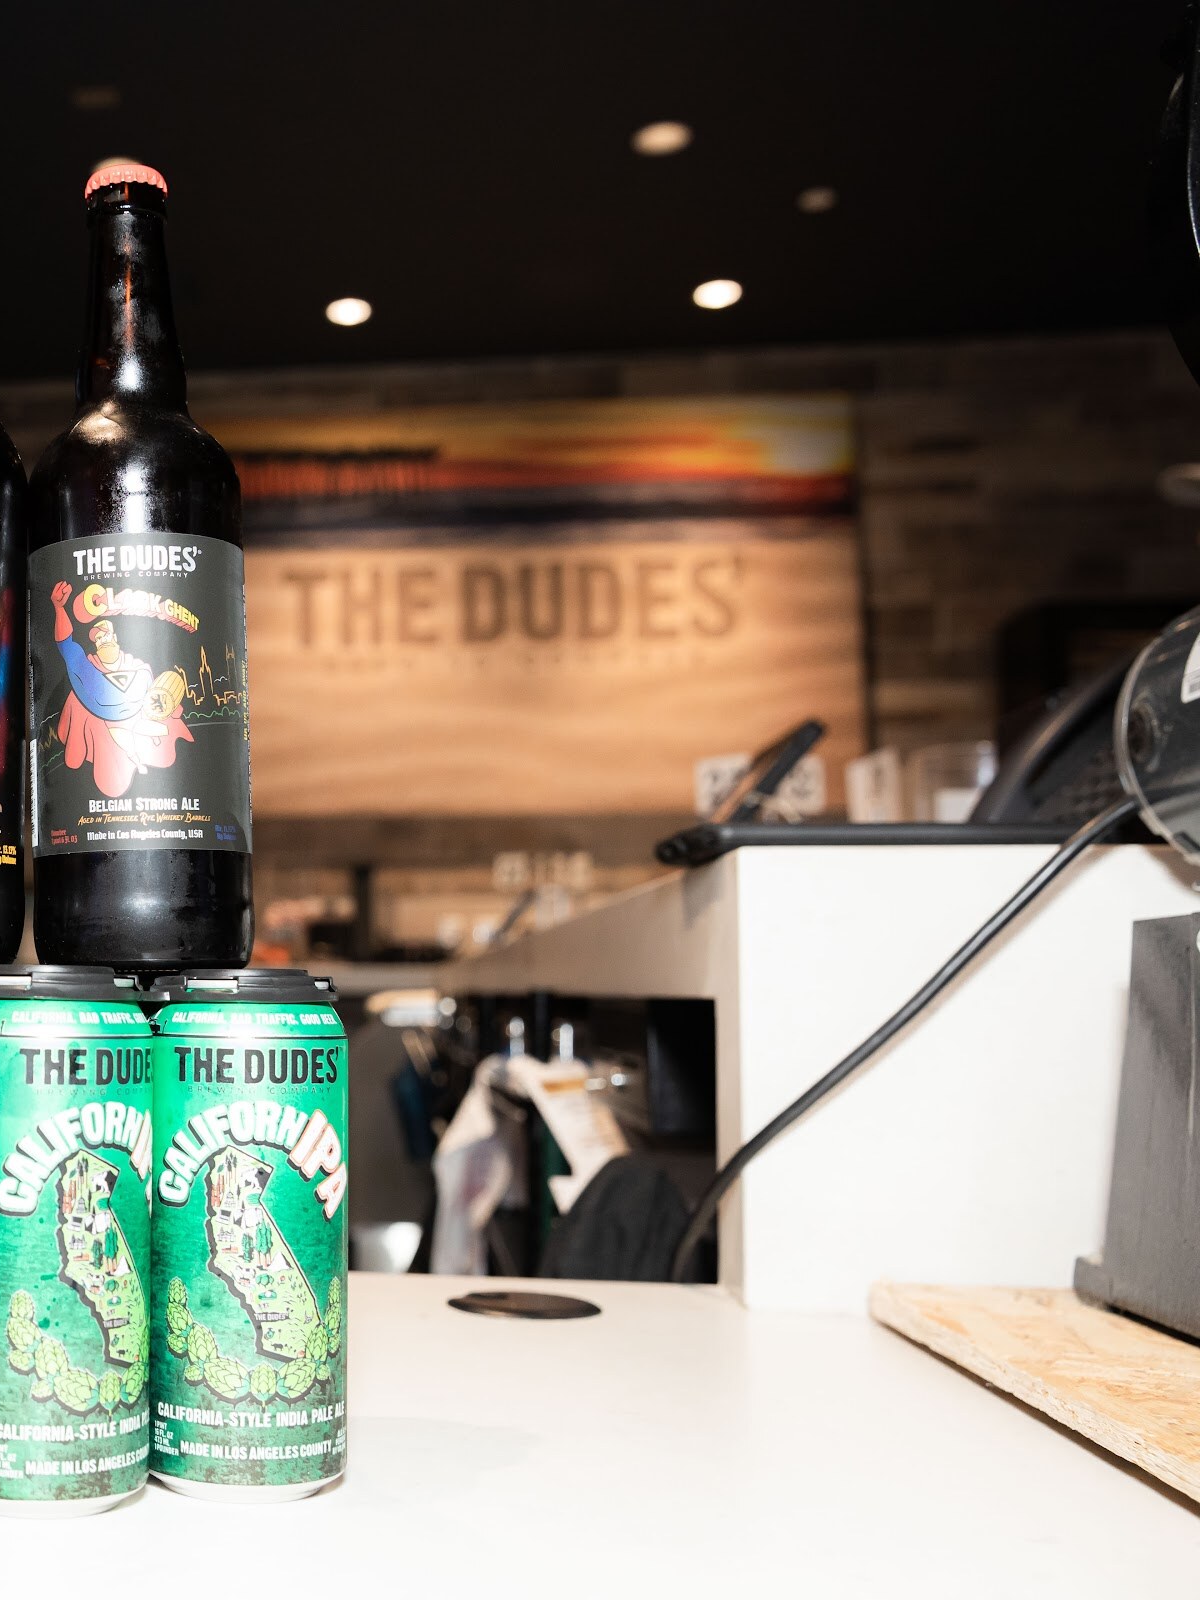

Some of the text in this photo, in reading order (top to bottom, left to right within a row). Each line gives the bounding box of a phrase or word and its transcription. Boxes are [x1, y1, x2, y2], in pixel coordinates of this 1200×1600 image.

[73, 545, 198, 576] THE DUDES'
[83, 571, 189, 581] BREWING COMPANY
[282, 567, 440, 648] THE
[460, 555, 744, 646] DUDES'
[163, 598, 200, 632] GHENT
[89, 797, 200, 813] BELGIAN STRONG ALE
[78, 812, 211, 826] AGED TENNESSEE RYE WHISKEY BARRELS
[87, 829, 203, 841] Made in Los Angeles County, USA
[172, 1011, 227, 1024] CALIFORNIA.
[229, 1012, 252, 1024] BAD
[255, 1012, 298, 1025] TRAFFIC.
[299, 1013, 321, 1025] GOOD
[19, 1048, 152, 1086] THE DUDE
[174, 1046, 340, 1085] THE DUDES'
[269, 1086, 331, 1095] COMPANY
[254, 1312, 267, 1322] THE
[157, 1401, 345, 1428] CALIFORNIA-STYLE INDIA PALE ALE
[119, 1415, 141, 1434] INDIA
[157, 1420, 167, 1430] PINT
[180, 1440, 210, 1458] MADE
[211, 1442, 223, 1458] IN
[224, 1443, 248, 1461] LOS
[250, 1444, 299, 1460] ANGELES
[300, 1439, 333, 1458] COUNTY
[26, 1451, 135, 1476] MADE IN LOS ANGELES
